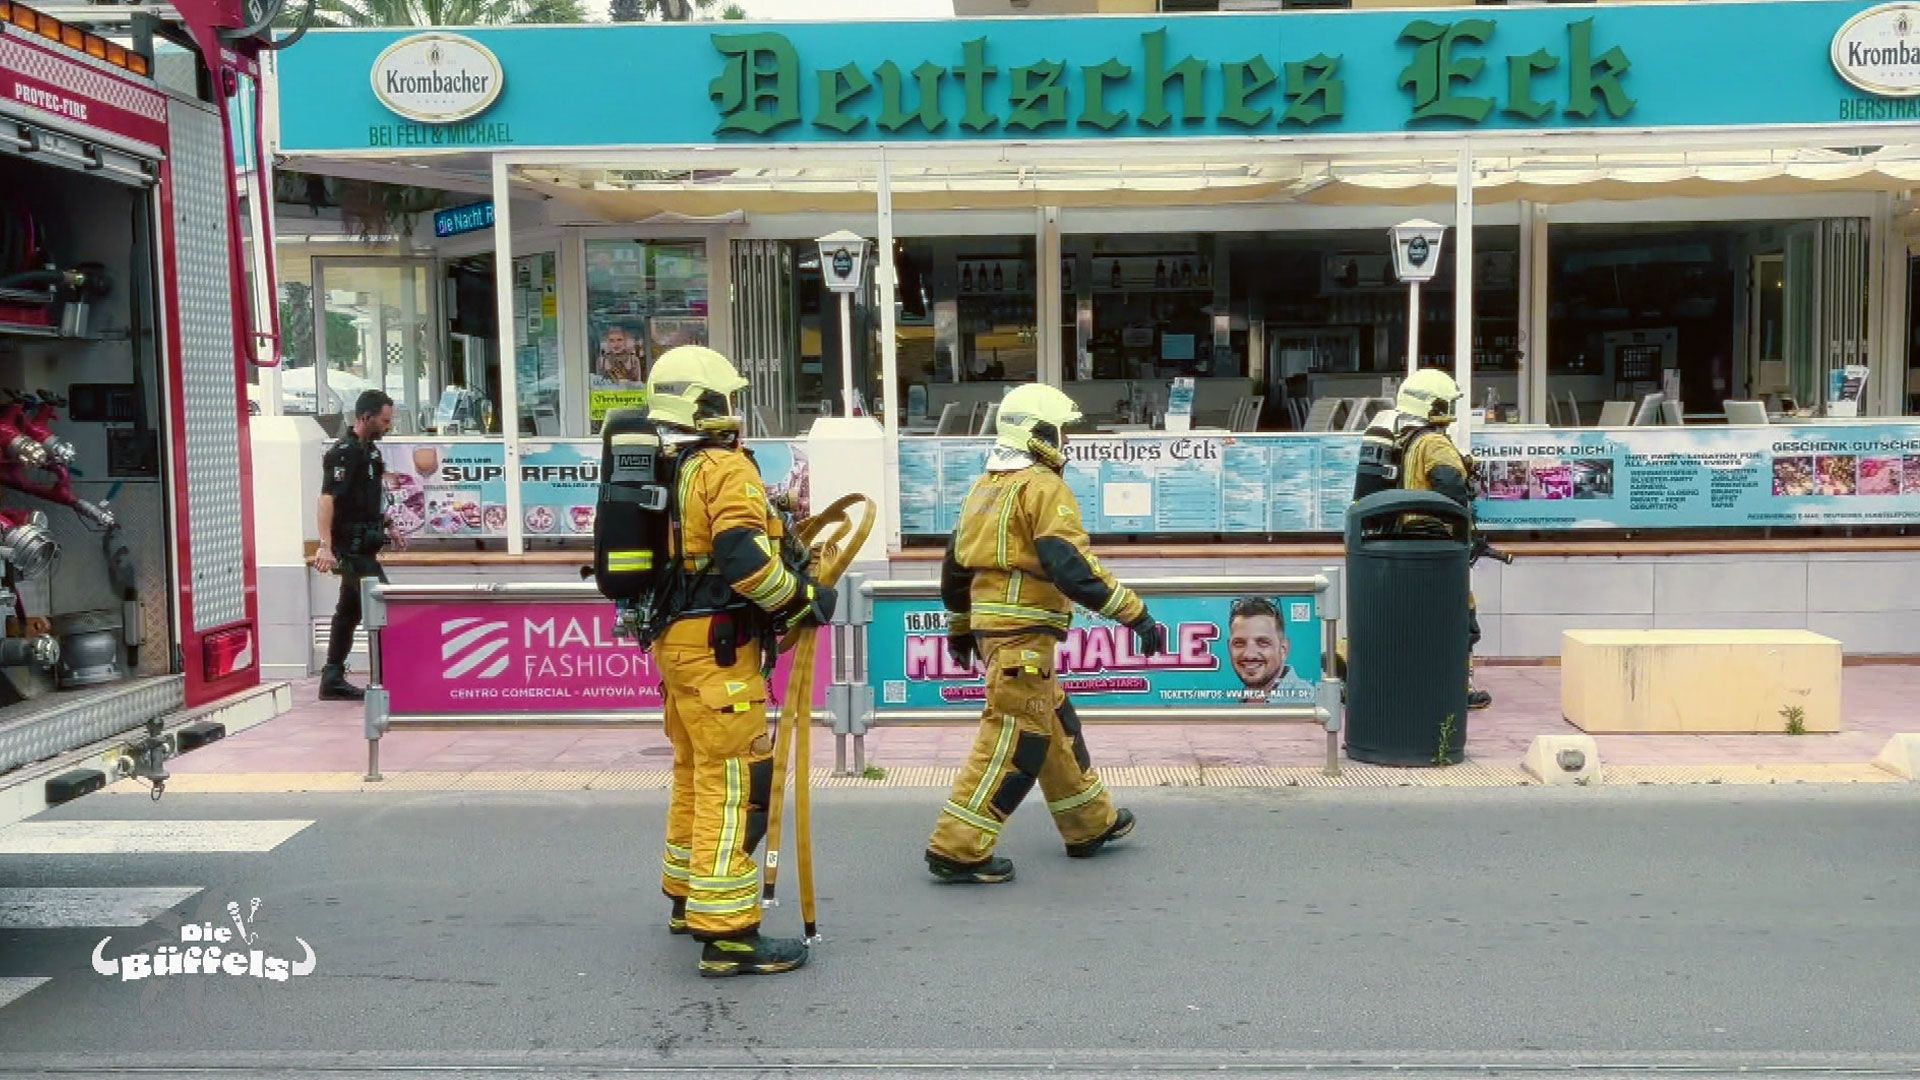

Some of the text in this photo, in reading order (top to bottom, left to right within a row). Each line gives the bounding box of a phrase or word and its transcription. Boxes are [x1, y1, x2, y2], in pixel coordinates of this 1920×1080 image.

[1848, 40, 1920, 66] Kromba
[386, 69, 489, 94] Krombacher
[708, 17, 1637, 138] Deutsches Eck
[15, 82, 87, 120] PROTEC-FIRE
[1840, 98, 1920, 120] BIERSTRA
[369, 122, 513, 146] BEI FELI & MICHAEL
[1063, 438, 1218, 463] eutsches Eck
[1471, 446, 1523, 457] CHLEIN
[1527, 446, 1566, 456] DECK
[441, 462, 599, 482] SUPRFRÜ
[525, 653, 649, 684] FASHION
[450, 686, 661, 699] CENTRO COMERCIAL AUTOVÍA PAL
